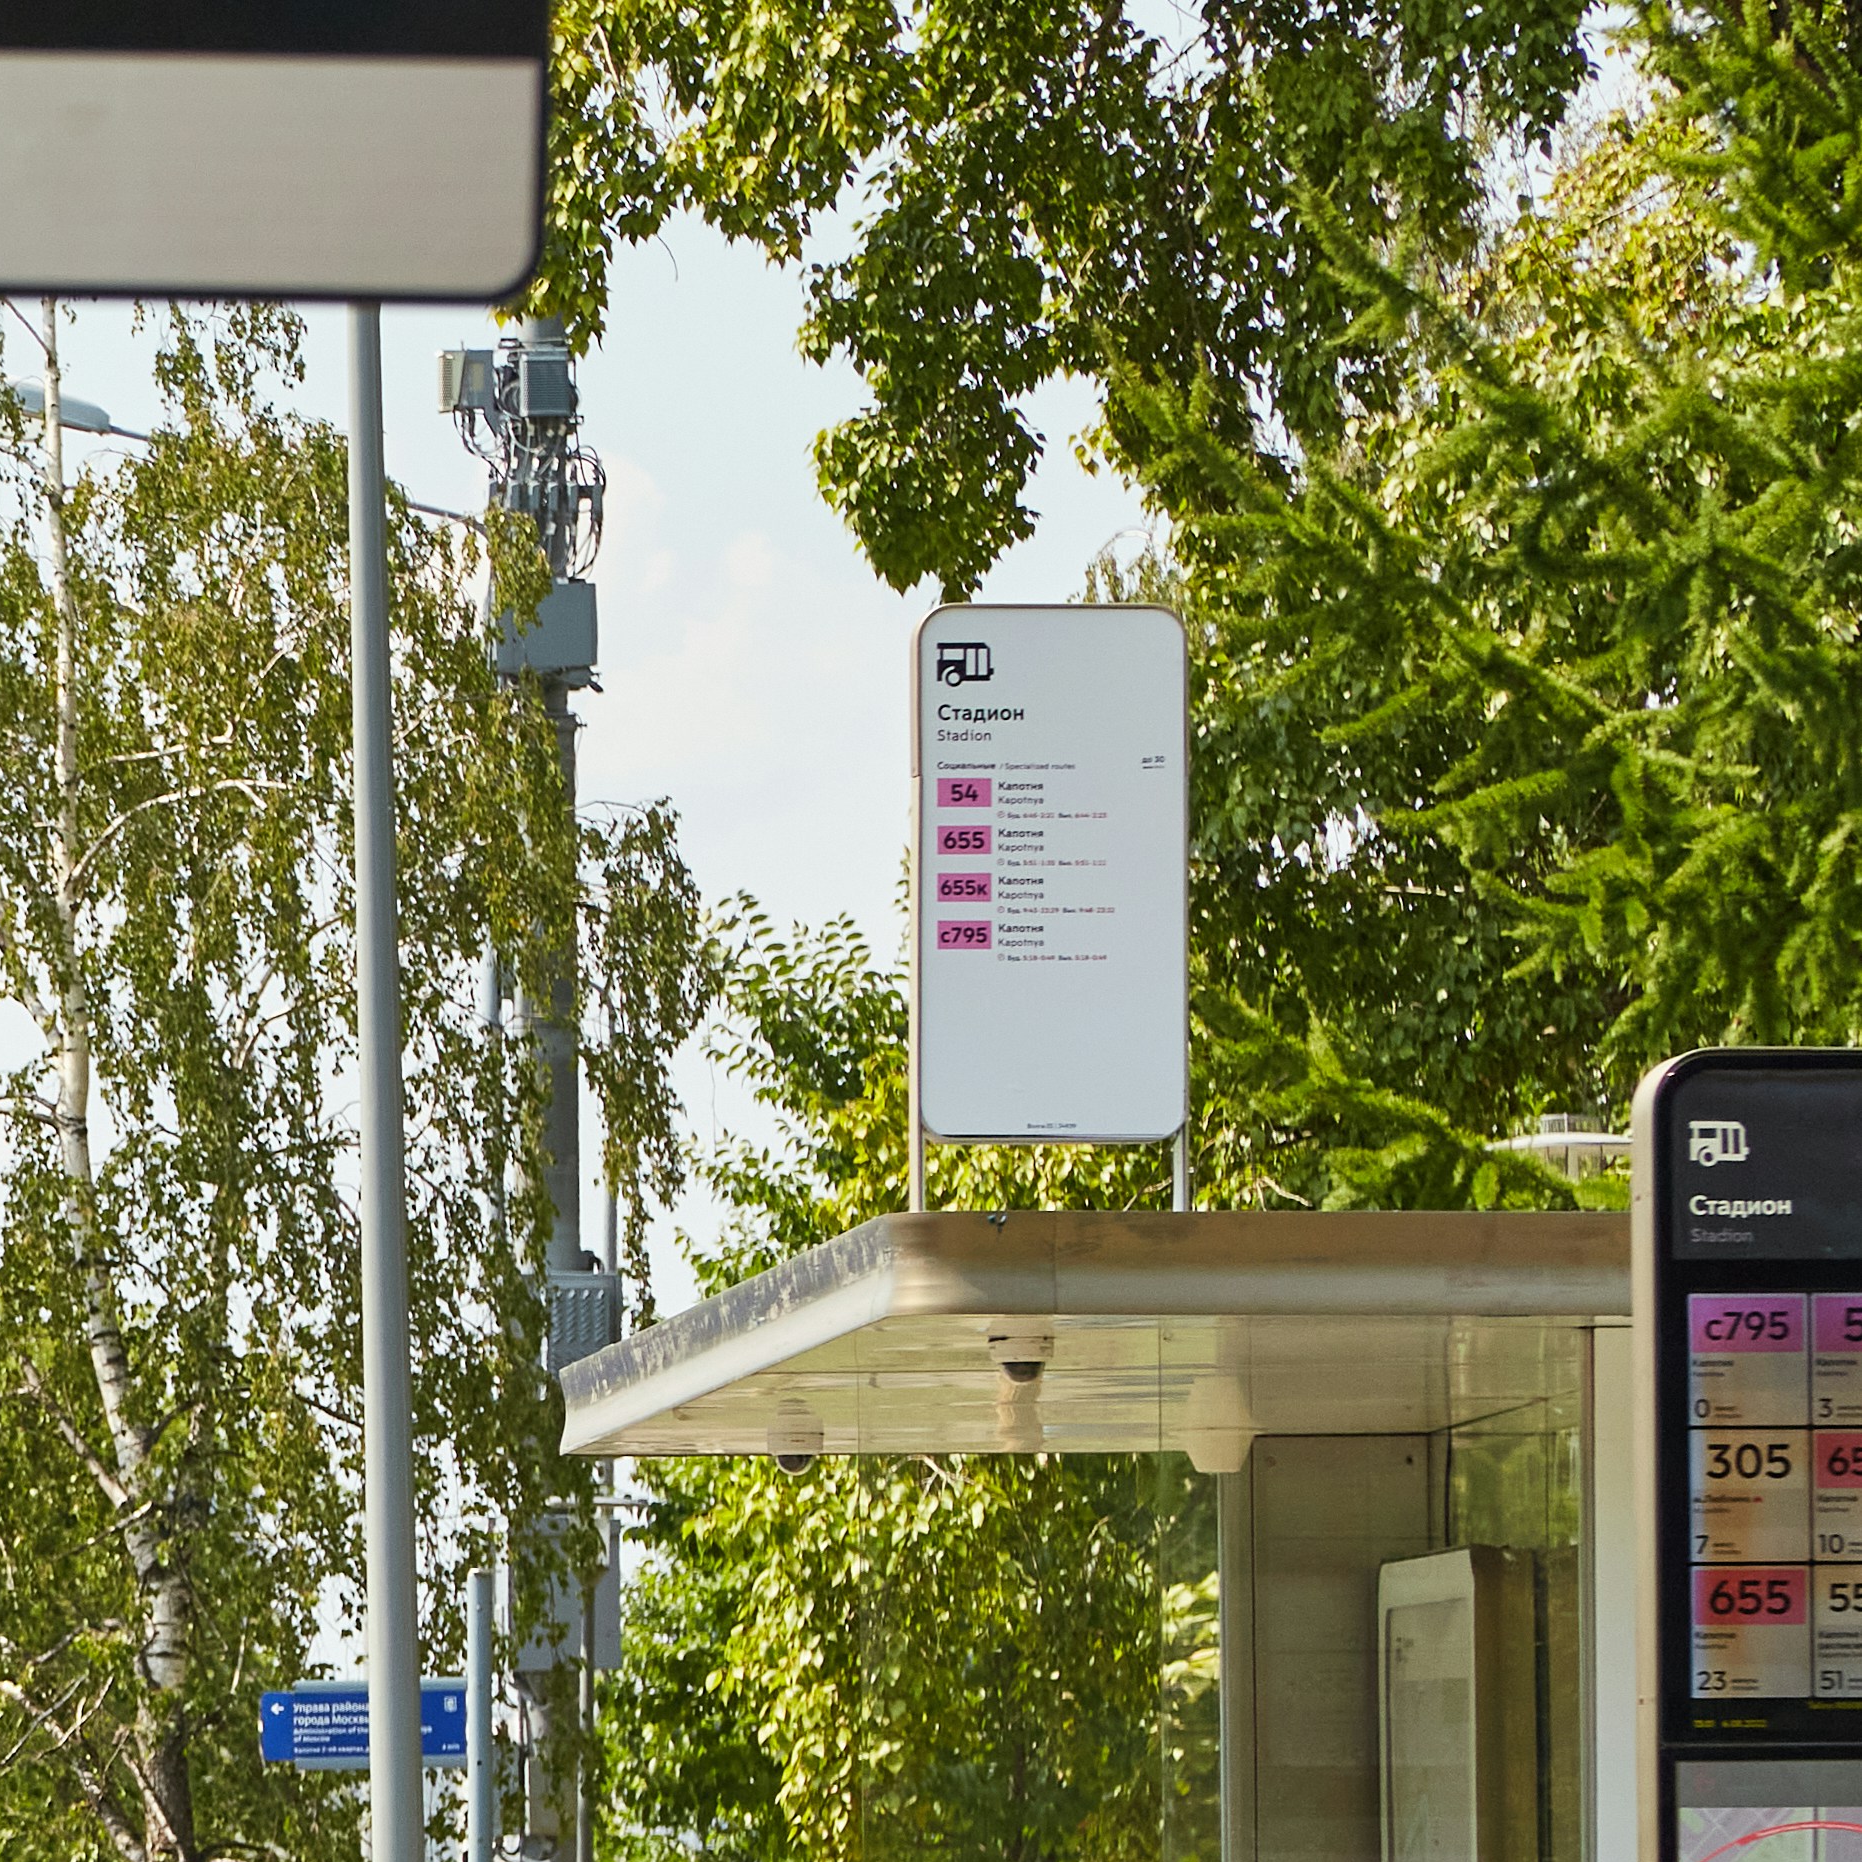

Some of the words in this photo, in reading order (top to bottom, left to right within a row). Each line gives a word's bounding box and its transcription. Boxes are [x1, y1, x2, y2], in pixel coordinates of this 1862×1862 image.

[937, 704, 1024, 723] Стадион
[937, 729, 992, 741] Stadion
[951, 783, 978, 802] 54
[998, 781, 1044, 791] Капотня
[943, 831, 985, 849] 655
[998, 828, 1044, 838] Капотня
[940, 879, 988, 896] 655к
[998, 876, 1044, 886] Капотня
[998, 924, 1044, 934] Капотня
[1689, 1194, 1792, 1218] Стадион
[1690, 1228, 1754, 1243] Stadion
[1694, 1398, 1710, 1418] 0
[1818, 1398, 1833, 1418] 3
[1706, 1443, 1792, 1479] 305
[1695, 1534, 1709, 1554] 7
[1818, 1534, 1844, 1554] 10
[1709, 1580, 1791, 1615] 655
[1696, 1670, 1727, 1691] 23
[1819, 1670, 1843, 1690] 51
[293, 1702, 330, 1715] Управа
[293, 1715, 330, 1728] города
